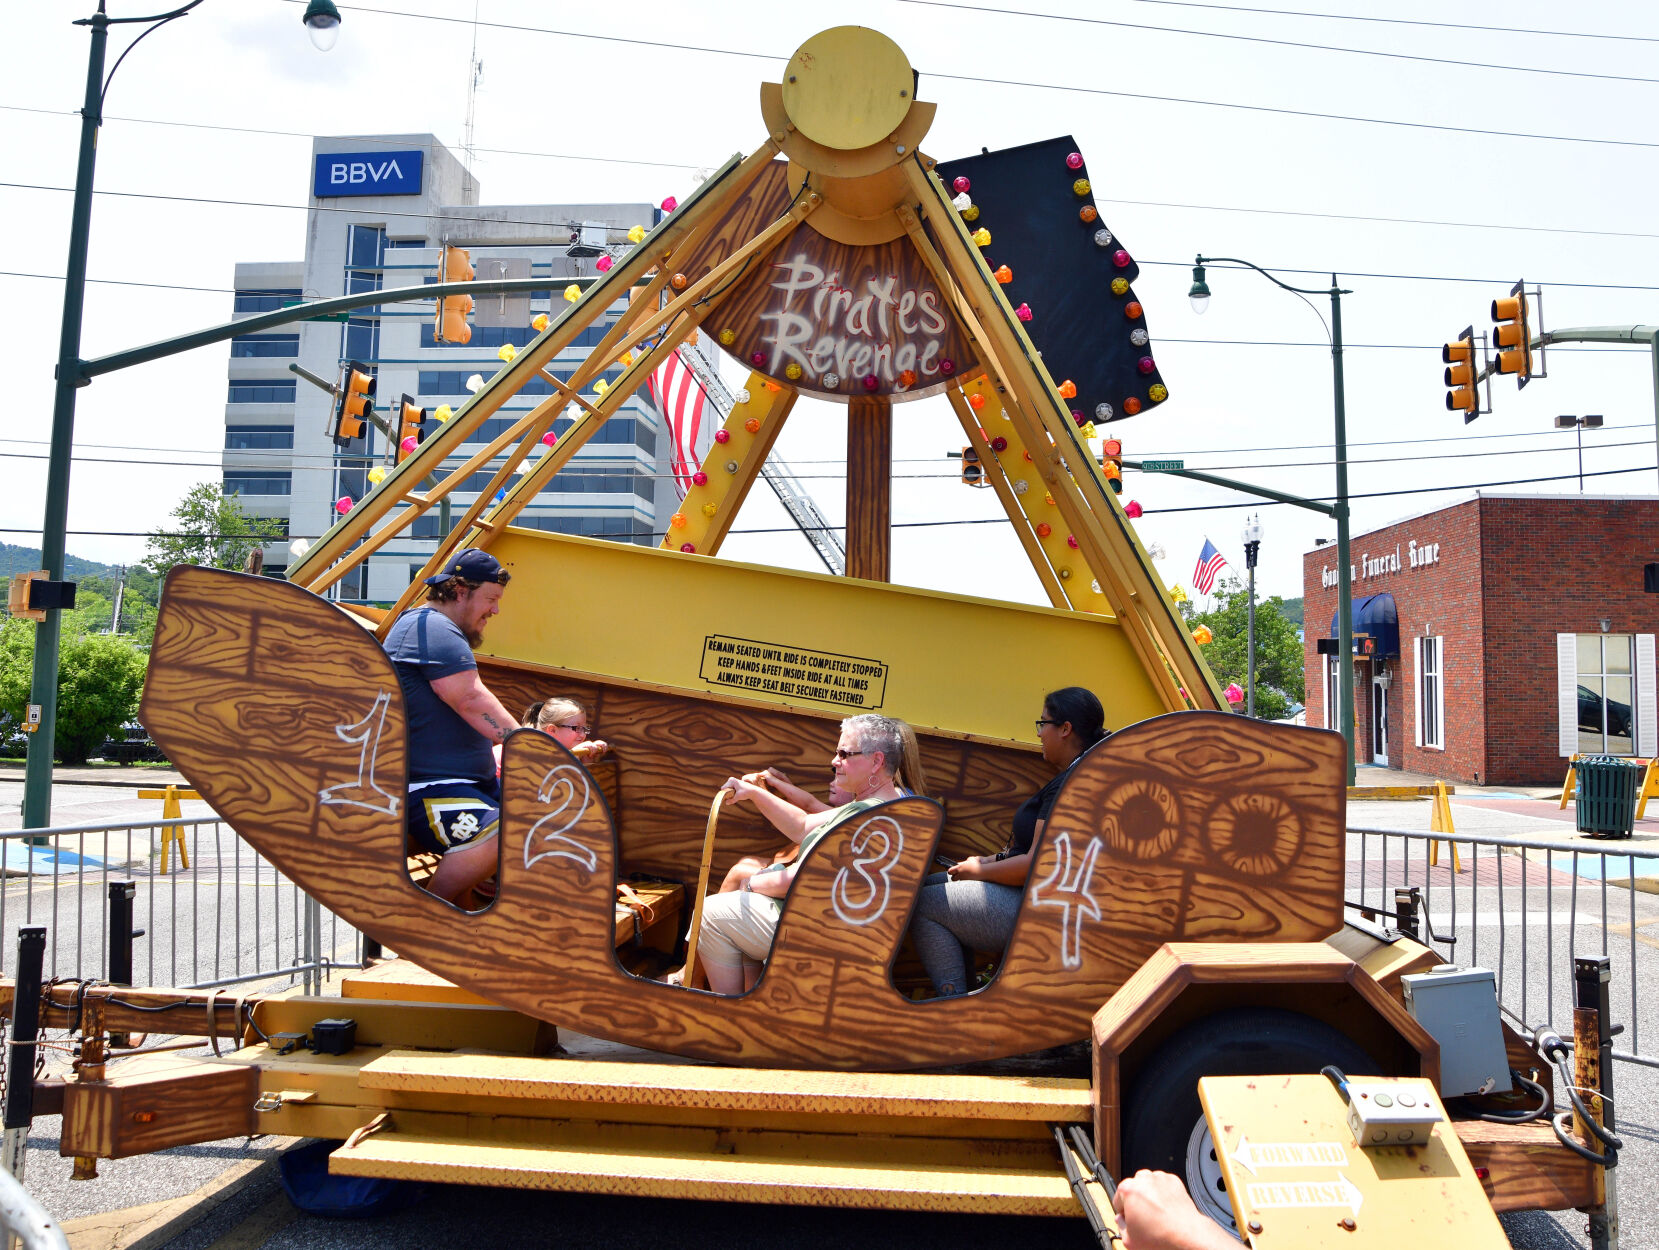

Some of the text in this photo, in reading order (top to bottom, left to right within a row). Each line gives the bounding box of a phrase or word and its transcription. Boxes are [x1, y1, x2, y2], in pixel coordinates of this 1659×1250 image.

[330, 159, 404, 184] BBVA
[768, 254, 947, 339] Pirates
[1154, 461, 1184, 470] STREET
[1362, 543, 1402, 579] Funeral
[1408, 540, 1440, 568] Home
[708, 640, 883, 678] REMAIN SEATED UNTIL RIDE IS COMPLETELY STOPPED
[717, 656, 735, 668] KEEP
[735, 659, 760, 673] HANDS
[783, 667, 806, 681] INSIDE
[807, 671, 822, 683] RIDE
[823, 674, 833, 685] AT
[833, 675, 846, 687] ALL
[847, 677, 869, 691] TIMES
[717, 671, 864, 705] ALWAYS KEEP SEAT BELT SECURELY FASTENED
[318, 688, 400, 816] 1
[523, 764, 597, 873] 2
[831, 815, 904, 925] 3
[1032, 832, 1103, 968] 4
[1249, 1146, 1345, 1163] FORWARD
[1251, 1185, 1350, 1204] REVERSE
